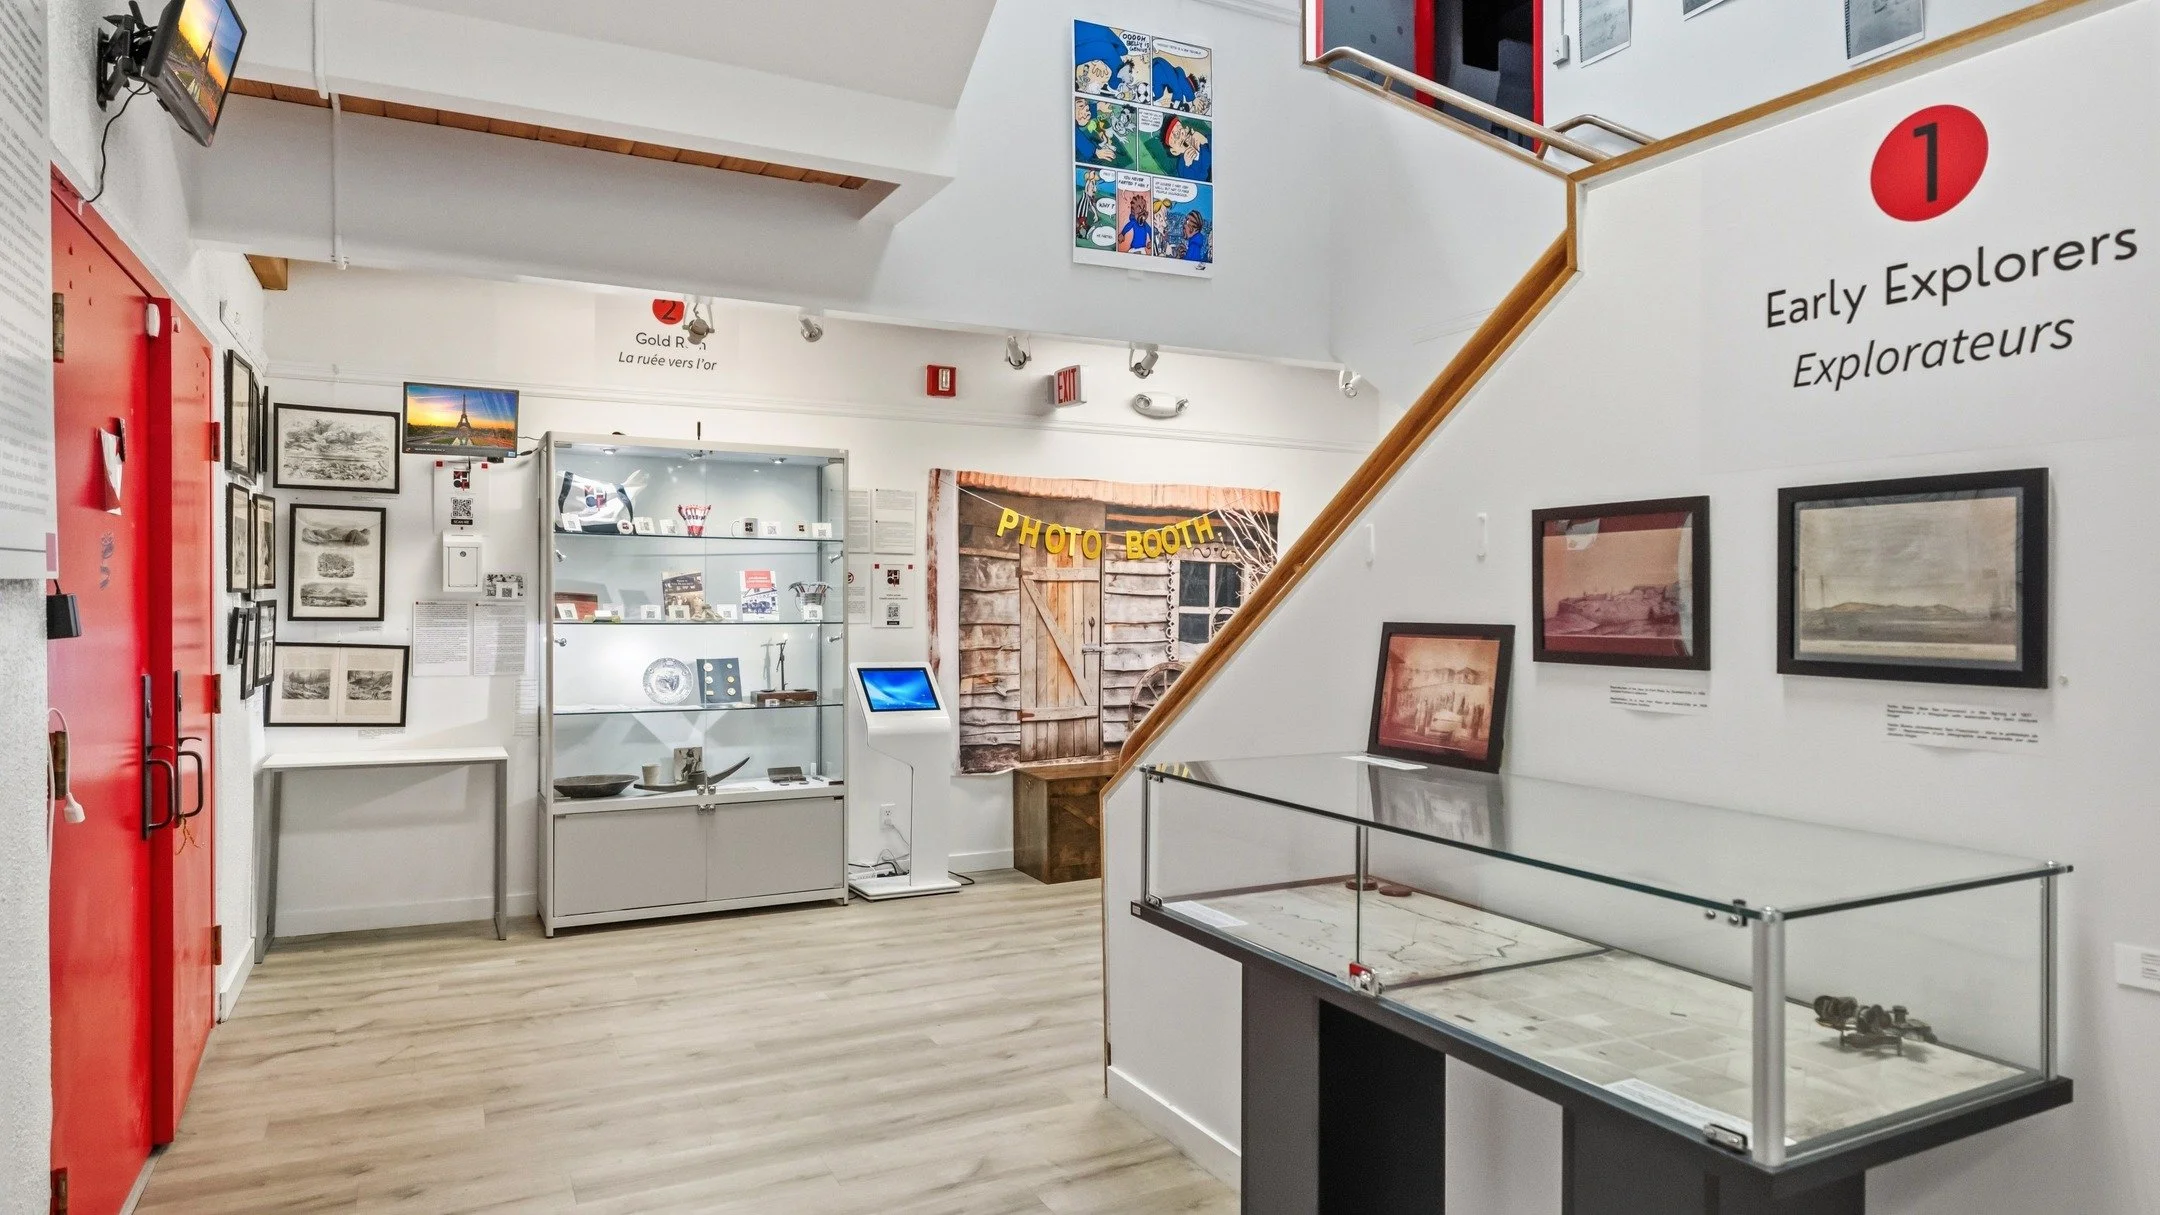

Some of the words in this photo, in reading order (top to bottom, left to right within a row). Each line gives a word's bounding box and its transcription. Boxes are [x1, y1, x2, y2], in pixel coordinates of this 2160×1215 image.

[1912, 121, 1939, 203] 1
[1766, 278, 1867, 328] Early
[1885, 227, 2138, 306] Explorers
[660, 299, 677, 321] 2
[618, 351, 634, 363] La
[637, 353, 665, 366] ruée
[668, 357, 693, 369] vers
[635, 332, 671, 348] Gold
[1793, 315, 2075, 391] Explorateurs
[1057, 368, 1077, 404] EXIT
[996, 507, 1102, 559] PHOTO
[1125, 514, 1215, 560] BOOTH
